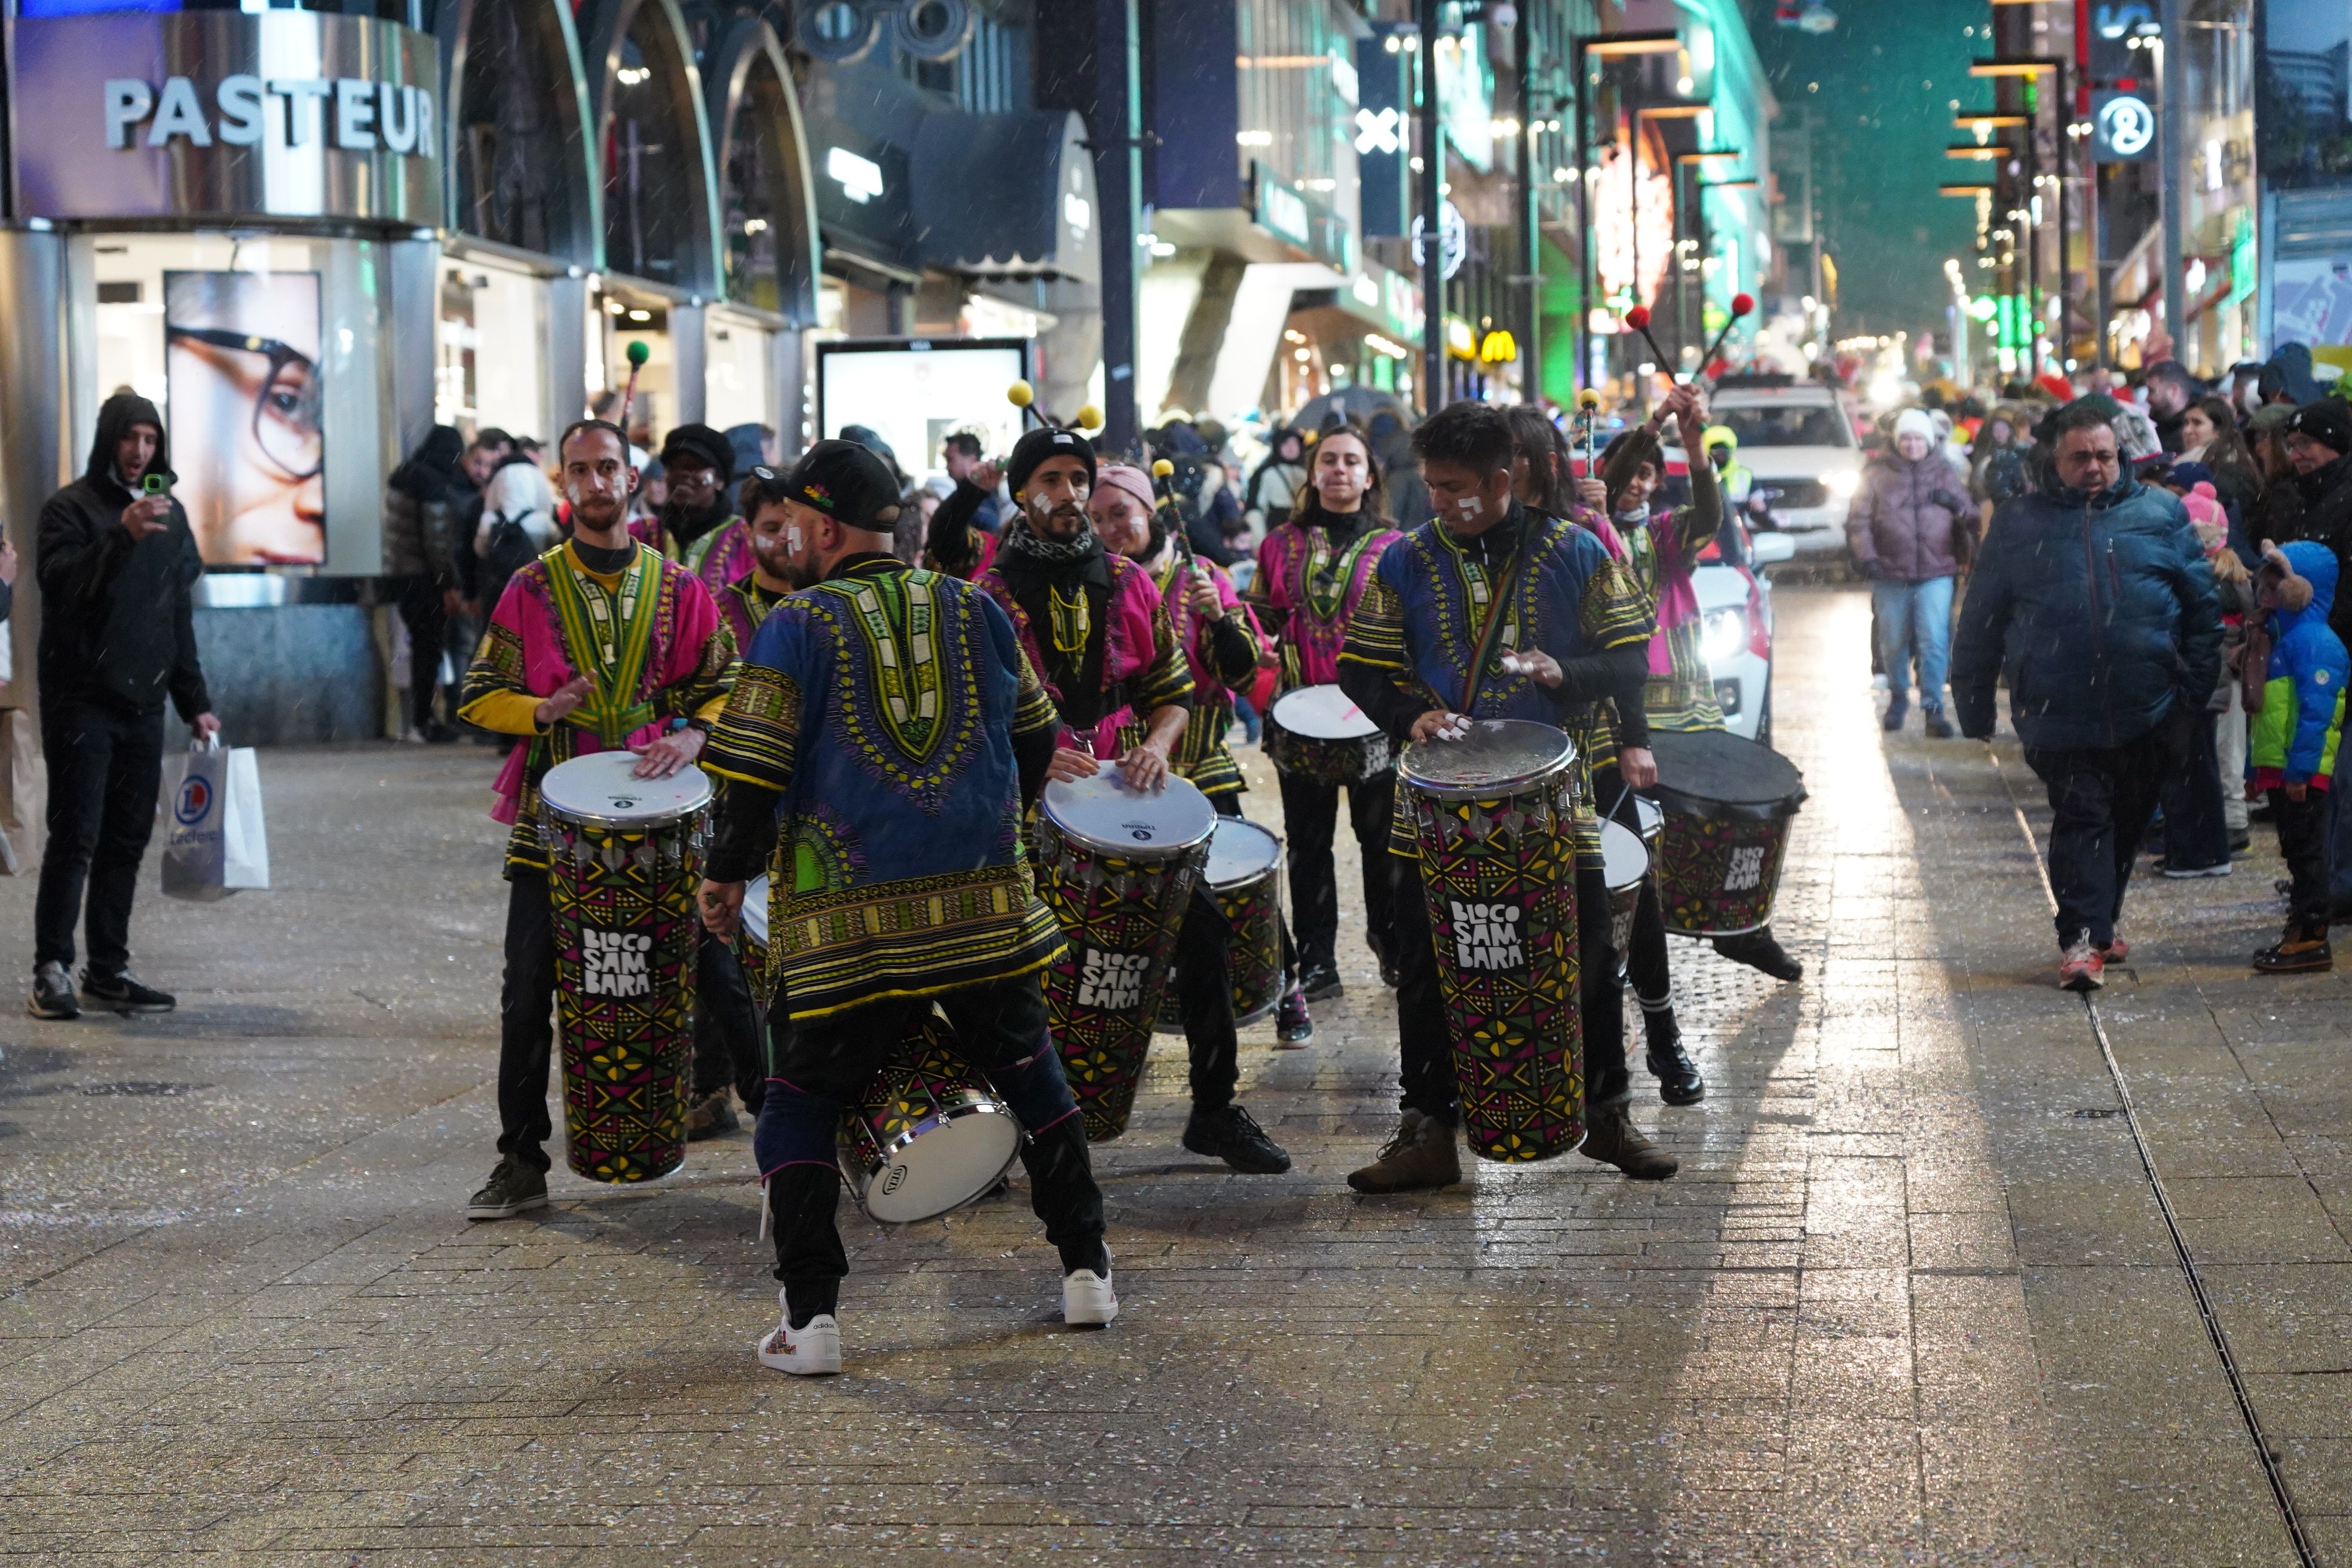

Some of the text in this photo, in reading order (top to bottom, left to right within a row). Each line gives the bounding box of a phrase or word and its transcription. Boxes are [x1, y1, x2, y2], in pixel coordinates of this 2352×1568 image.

[103, 74, 434, 158] PASTEUR
[1450, 901, 1520, 924] BLOCO
[583, 928, 652, 952] BLOCO
[1086, 948, 1150, 971] BLOCO
